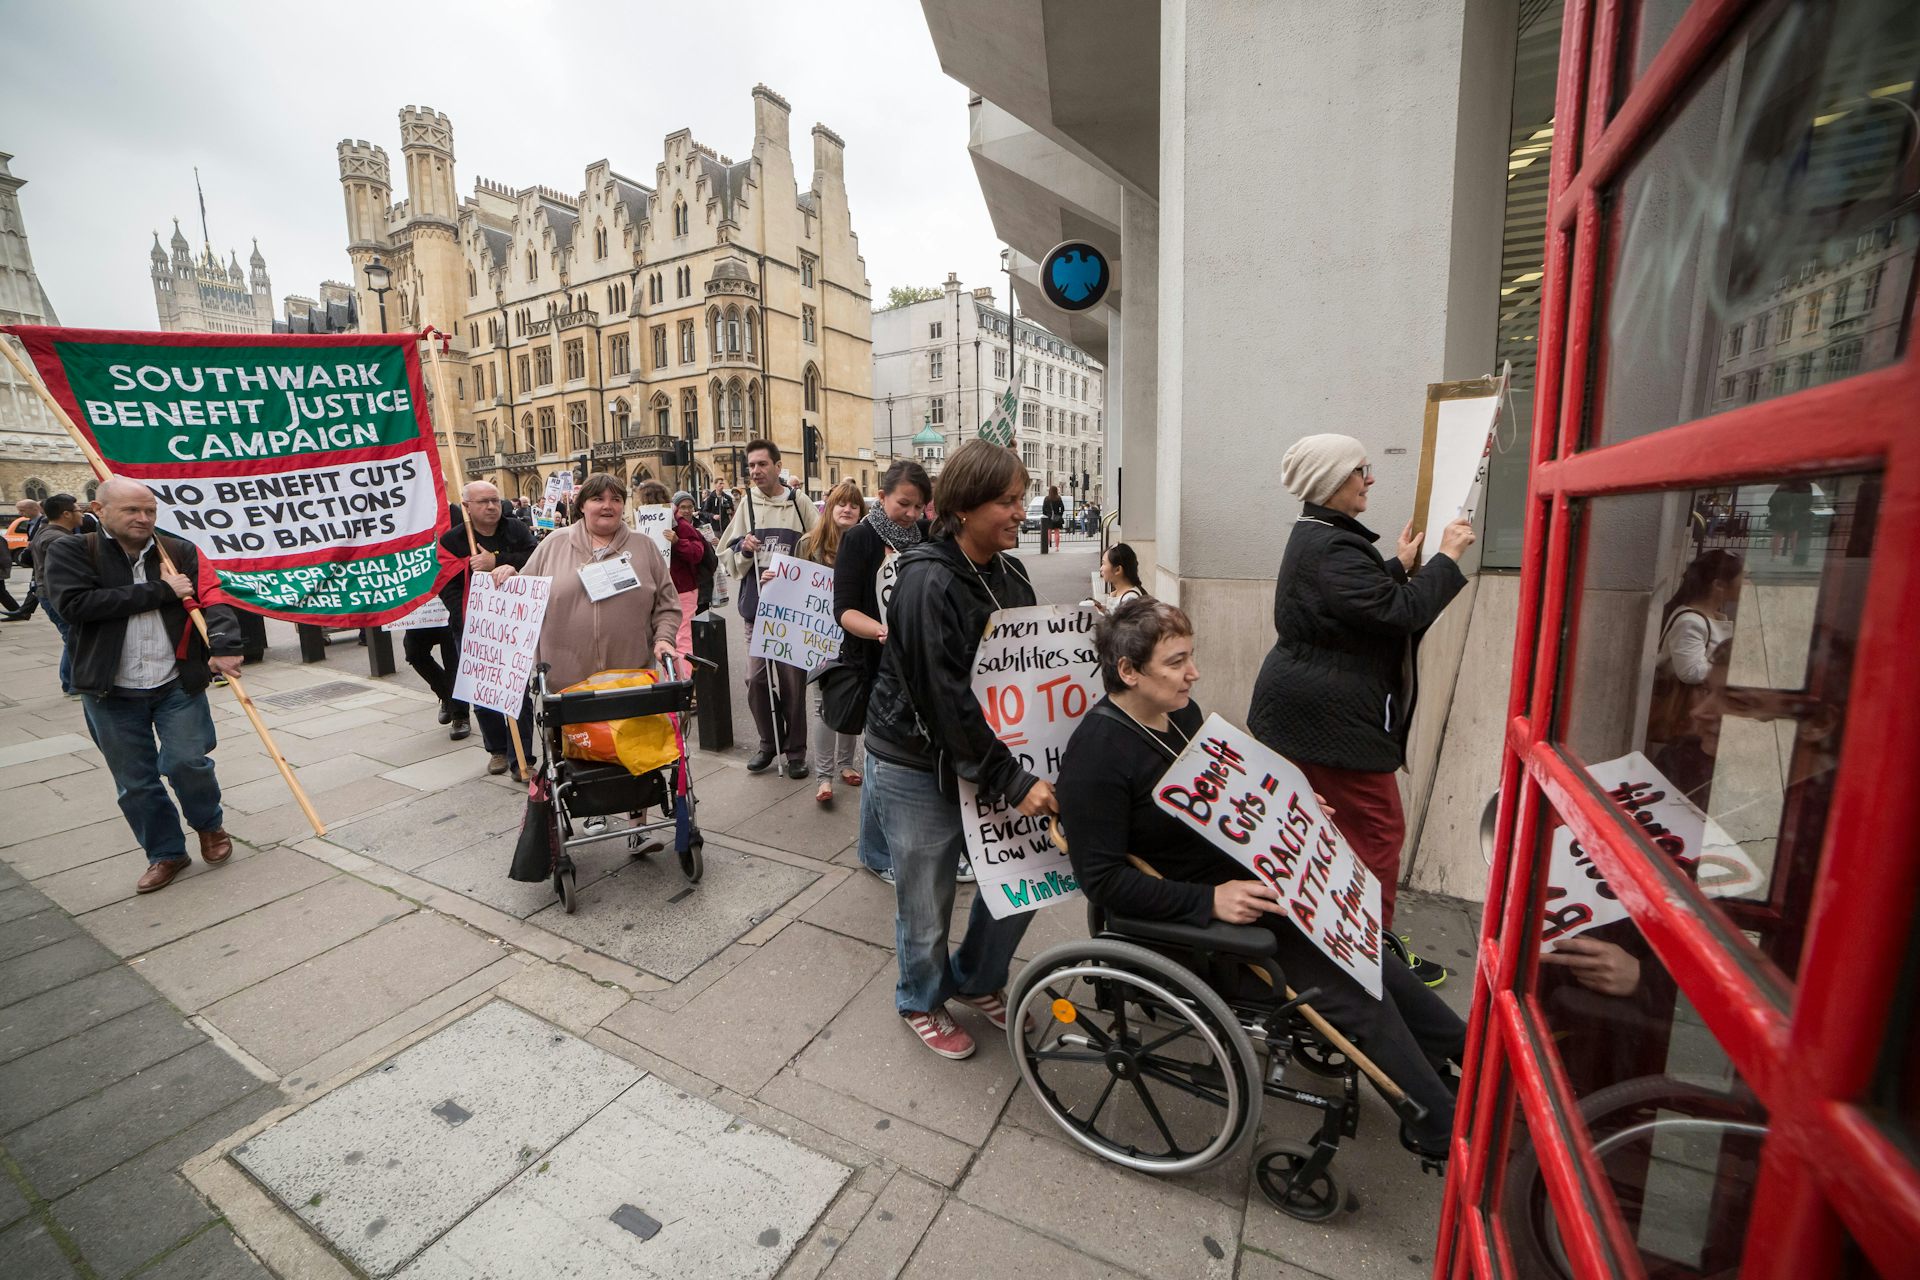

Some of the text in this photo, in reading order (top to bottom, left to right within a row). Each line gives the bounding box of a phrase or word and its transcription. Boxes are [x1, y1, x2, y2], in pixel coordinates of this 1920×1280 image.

[108, 363, 383, 393] SOUTHWARK
[85, 389, 410, 432] BENEFIT JUSTICE
[167, 422, 381, 461] CAMPAIGN
[147, 458, 417, 506] NO BENEFIT CUTS
[173, 486, 407, 531] NO EVICTIONS
[210, 514, 396, 554] NO BAILIFFS
[280, 584, 299, 594] A
[358, 560, 432, 589] FUNDED
[282, 567, 327, 583] FOR
[328, 559, 390, 577] SOCIAL
[776, 561, 801, 582] NO
[350, 584, 408, 606] STATE
[469, 592, 483, 612] FOR
[488, 596, 507, 617] ESA
[511, 602, 528, 622] AND
[805, 594, 830, 616] FOR
[757, 602, 813, 628] BENEFIT
[1047, 611, 1098, 634] with
[463, 638, 505, 666] UNIVERSAL
[761, 638, 793, 660] FOR
[762, 620, 841, 653] NO TARGE
[462, 660, 502, 686] COMPUTER
[1159, 737, 1247, 827] Benefit
[1218, 792, 1267, 845] Cuts
[1289, 826, 1337, 934] ATTACK
[1323, 919, 1355, 968] the
[1353, 907, 1380, 967] kind
